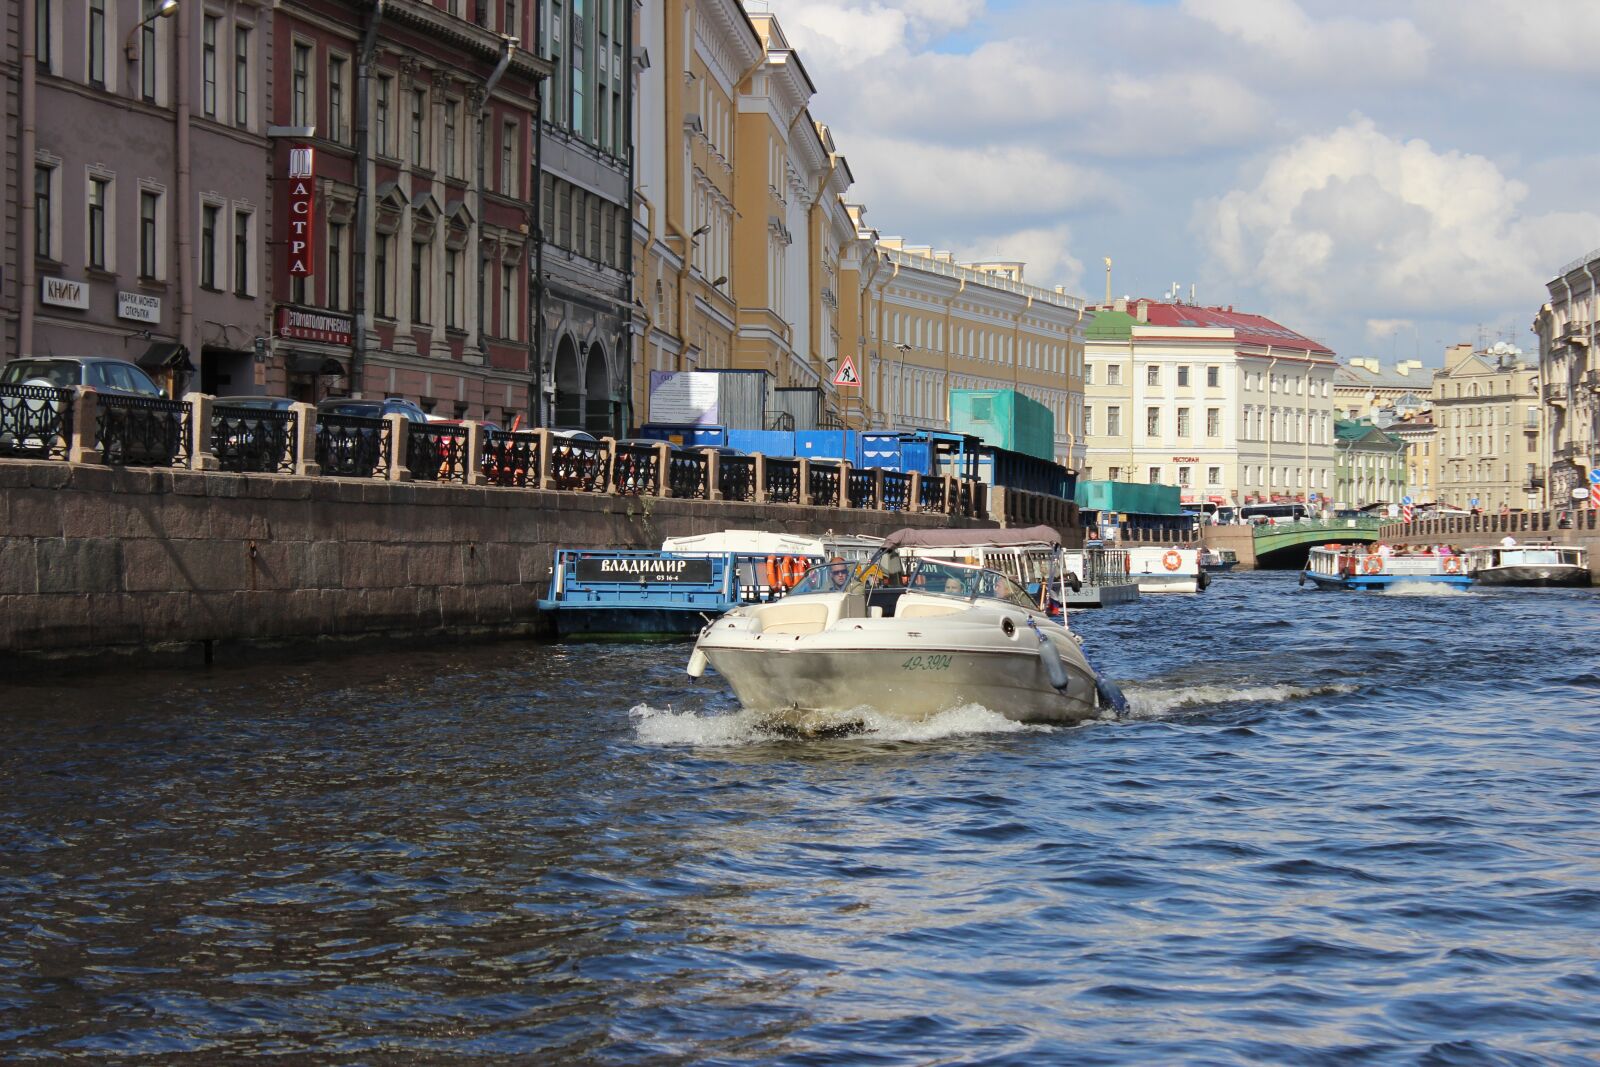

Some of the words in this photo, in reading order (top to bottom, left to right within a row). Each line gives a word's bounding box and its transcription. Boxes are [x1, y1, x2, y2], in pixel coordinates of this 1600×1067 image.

[290, 182, 308, 272] АСТРА
[48, 280, 80, 302] КНИГИ
[139, 296, 159, 308] МОНЕТЫ
[125, 306, 150, 319] ОТКРЫТКИ
[289, 311, 351, 334] СТОМАТОЛОГИЧЕСКАЯ
[601, 560, 686, 574] ВЛАДИМИР
[901, 654, 953, 671] 49-3904
